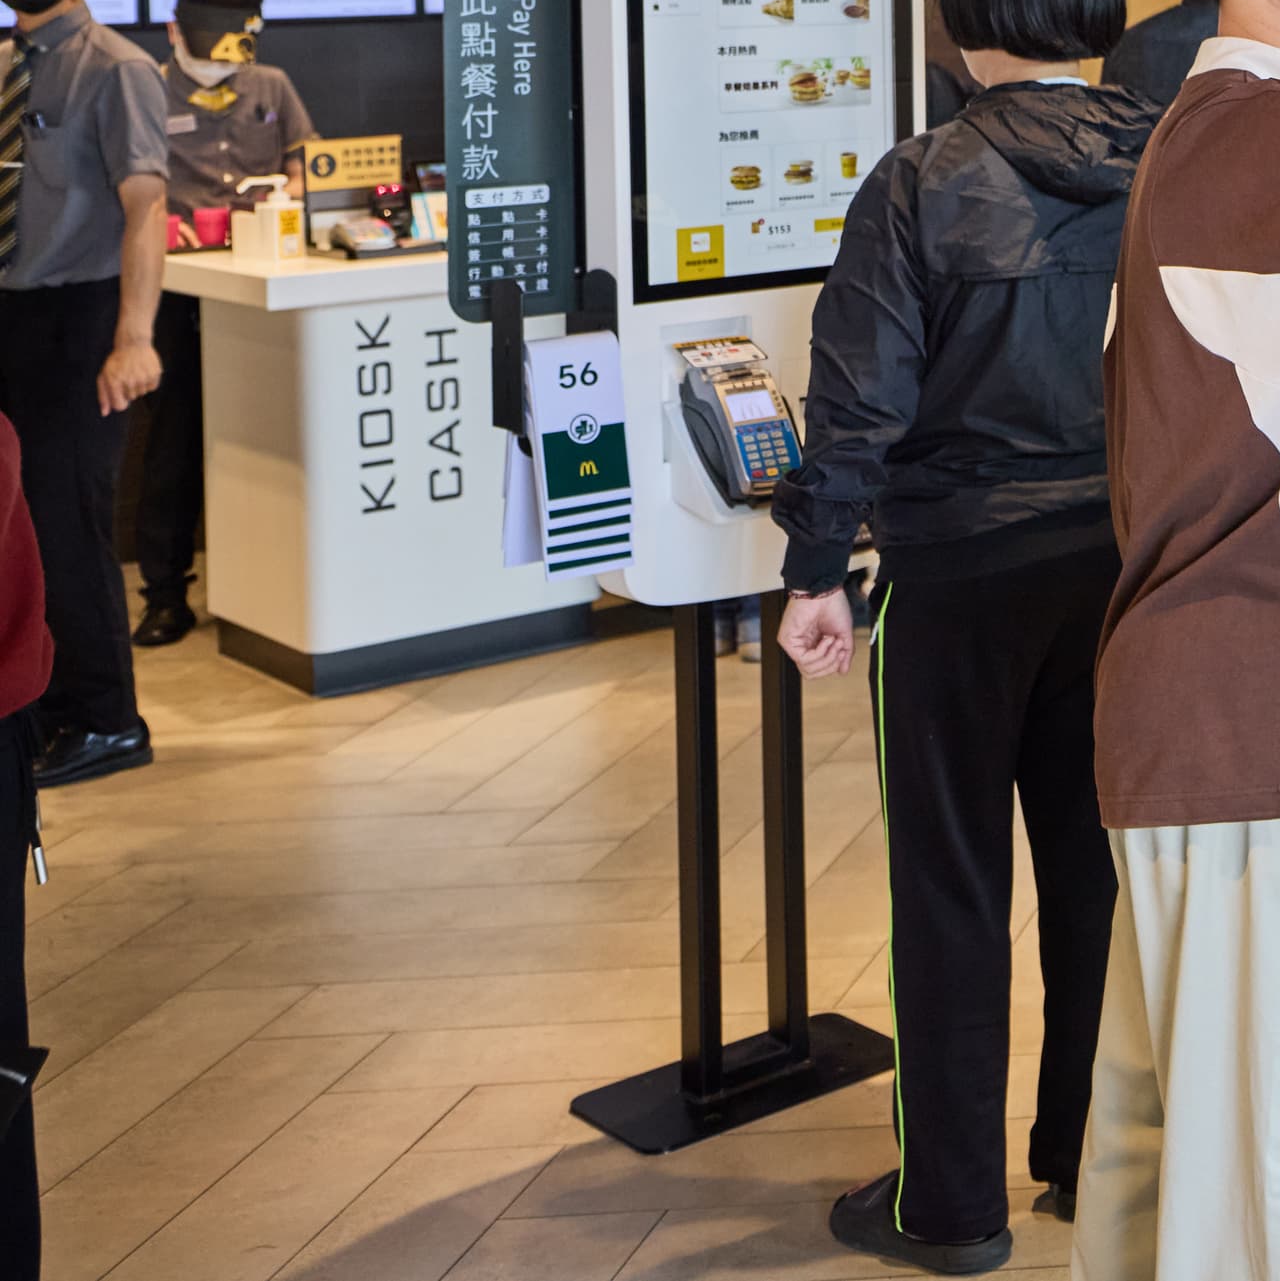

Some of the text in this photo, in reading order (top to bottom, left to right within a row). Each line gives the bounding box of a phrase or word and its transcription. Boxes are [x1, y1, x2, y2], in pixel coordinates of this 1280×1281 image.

[512, 41, 537, 96] Here
[471, 188, 545, 205] 支付方式
[467, 208, 549, 228] 點點卡
[467, 226, 549, 246] 信用卡
[467, 260, 549, 282] 行動支付
[558, 361, 599, 390] 56
[355, 313, 397, 515] KIOSK
[425, 327, 462, 503] CASH
